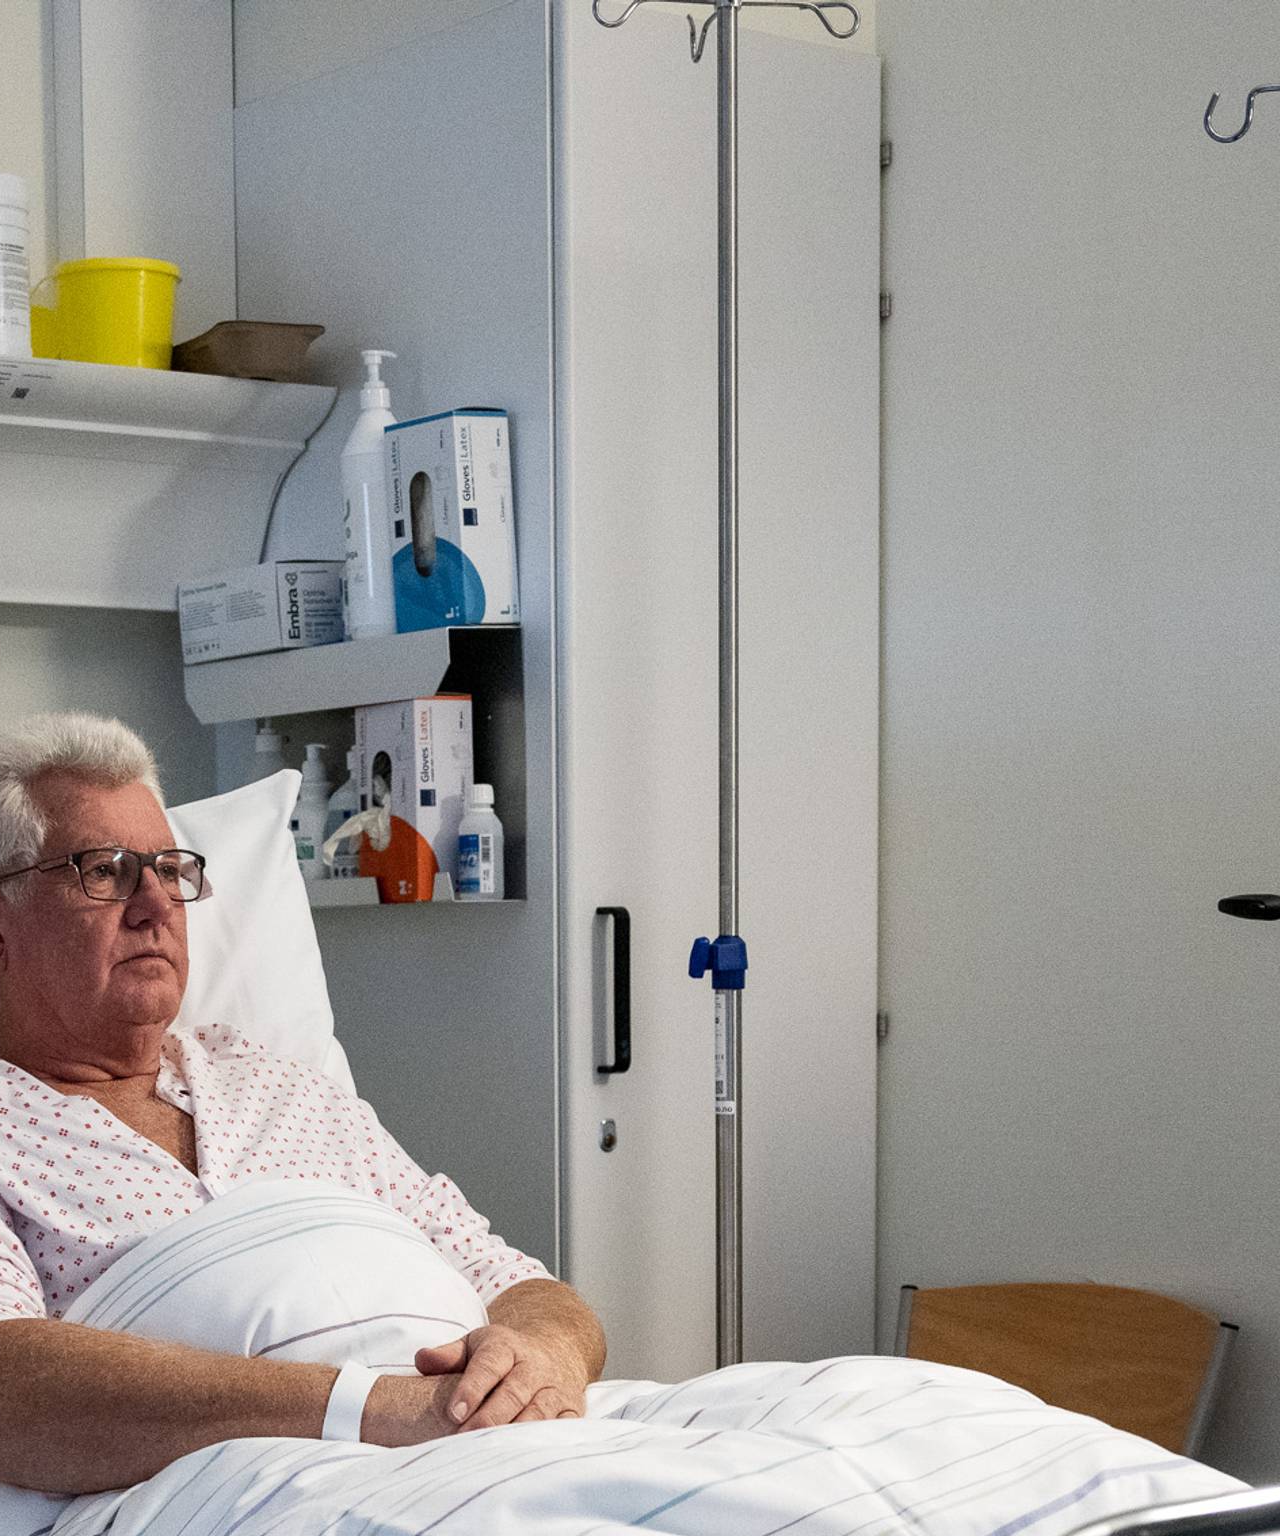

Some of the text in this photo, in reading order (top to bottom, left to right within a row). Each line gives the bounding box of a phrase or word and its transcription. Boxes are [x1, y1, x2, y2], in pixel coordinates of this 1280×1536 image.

[460, 427, 471, 502] Gloves Latex
[288, 588, 300, 640] Embra
[419, 711, 429, 783] Gloves Latex
